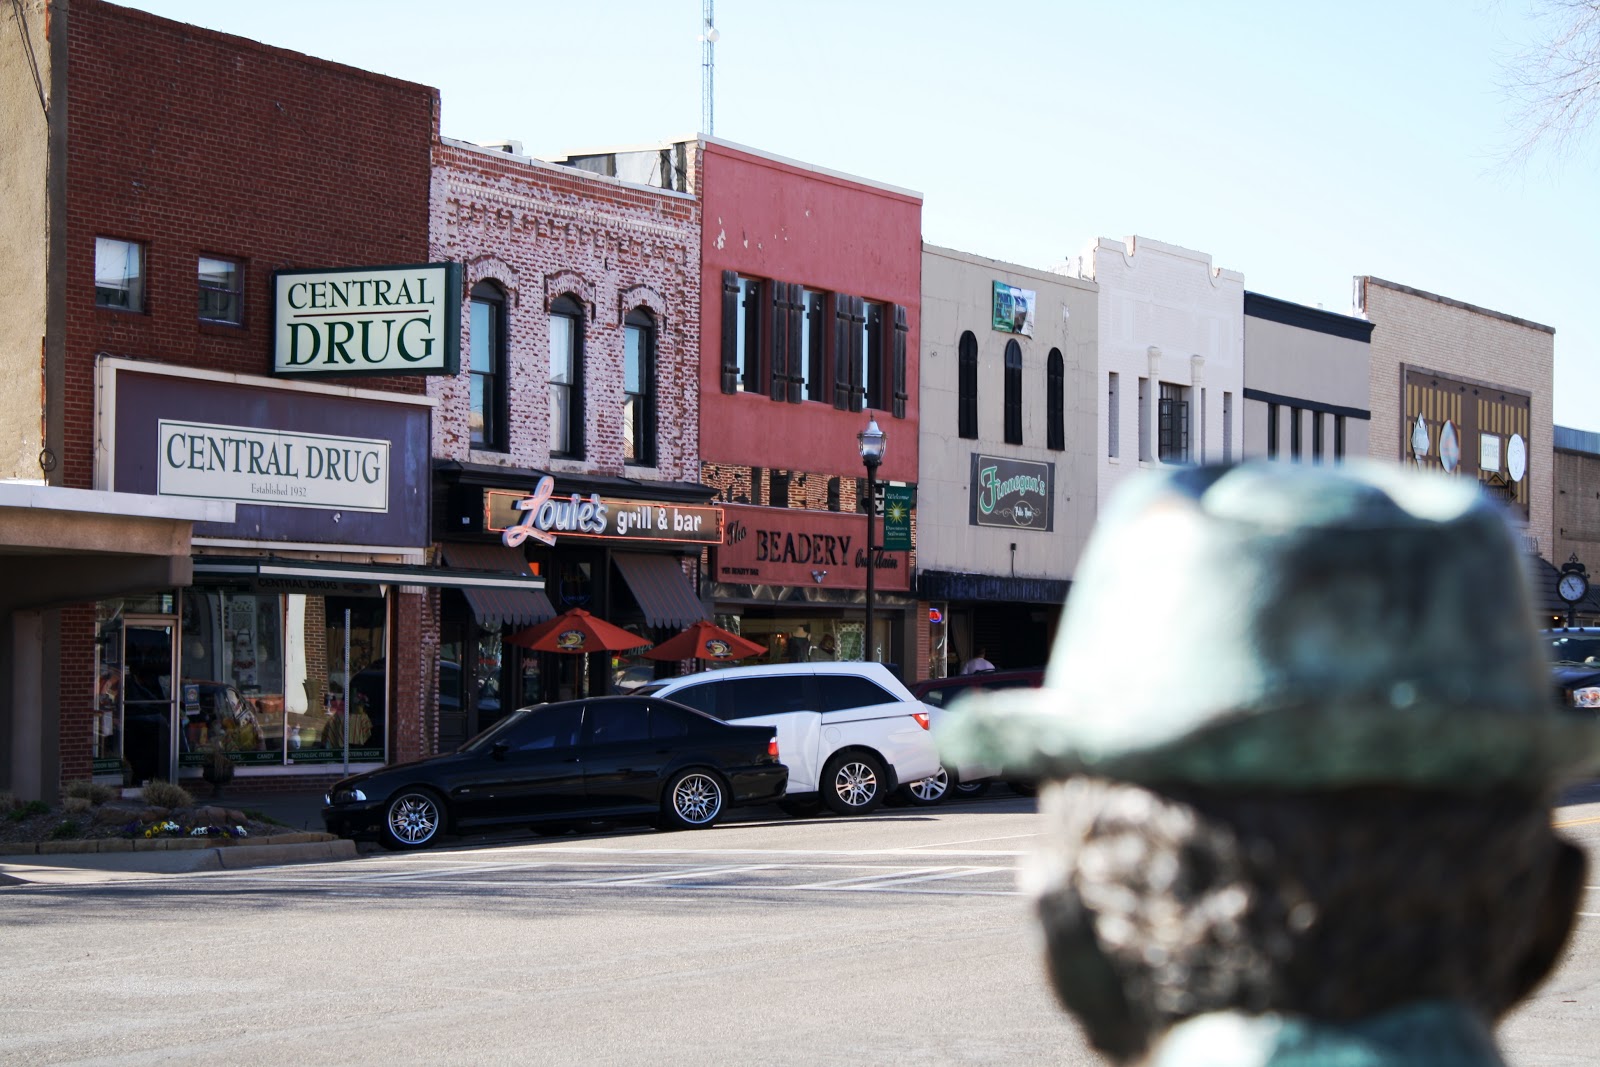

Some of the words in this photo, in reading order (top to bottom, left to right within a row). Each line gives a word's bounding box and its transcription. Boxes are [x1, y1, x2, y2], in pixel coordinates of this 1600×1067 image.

[287, 278, 435, 310] CENTRAL
[286, 315, 436, 366] DRUG
[166, 433, 298, 479] CENTRAL
[306, 445, 381, 484] DRUG
[251, 482, 288, 496] Established
[290, 486, 307, 497] 1932
[502, 475, 609, 547] Louie's
[617, 506, 652, 535] grill
[657, 507, 669, 530] &
[674, 508, 702, 532] bar
[980, 465, 1045, 515] Finnegan's
[756, 529, 852, 566] BEADERY
[258, 577, 306, 589] CENTRAL
[307, 580, 338, 590] DRUG
